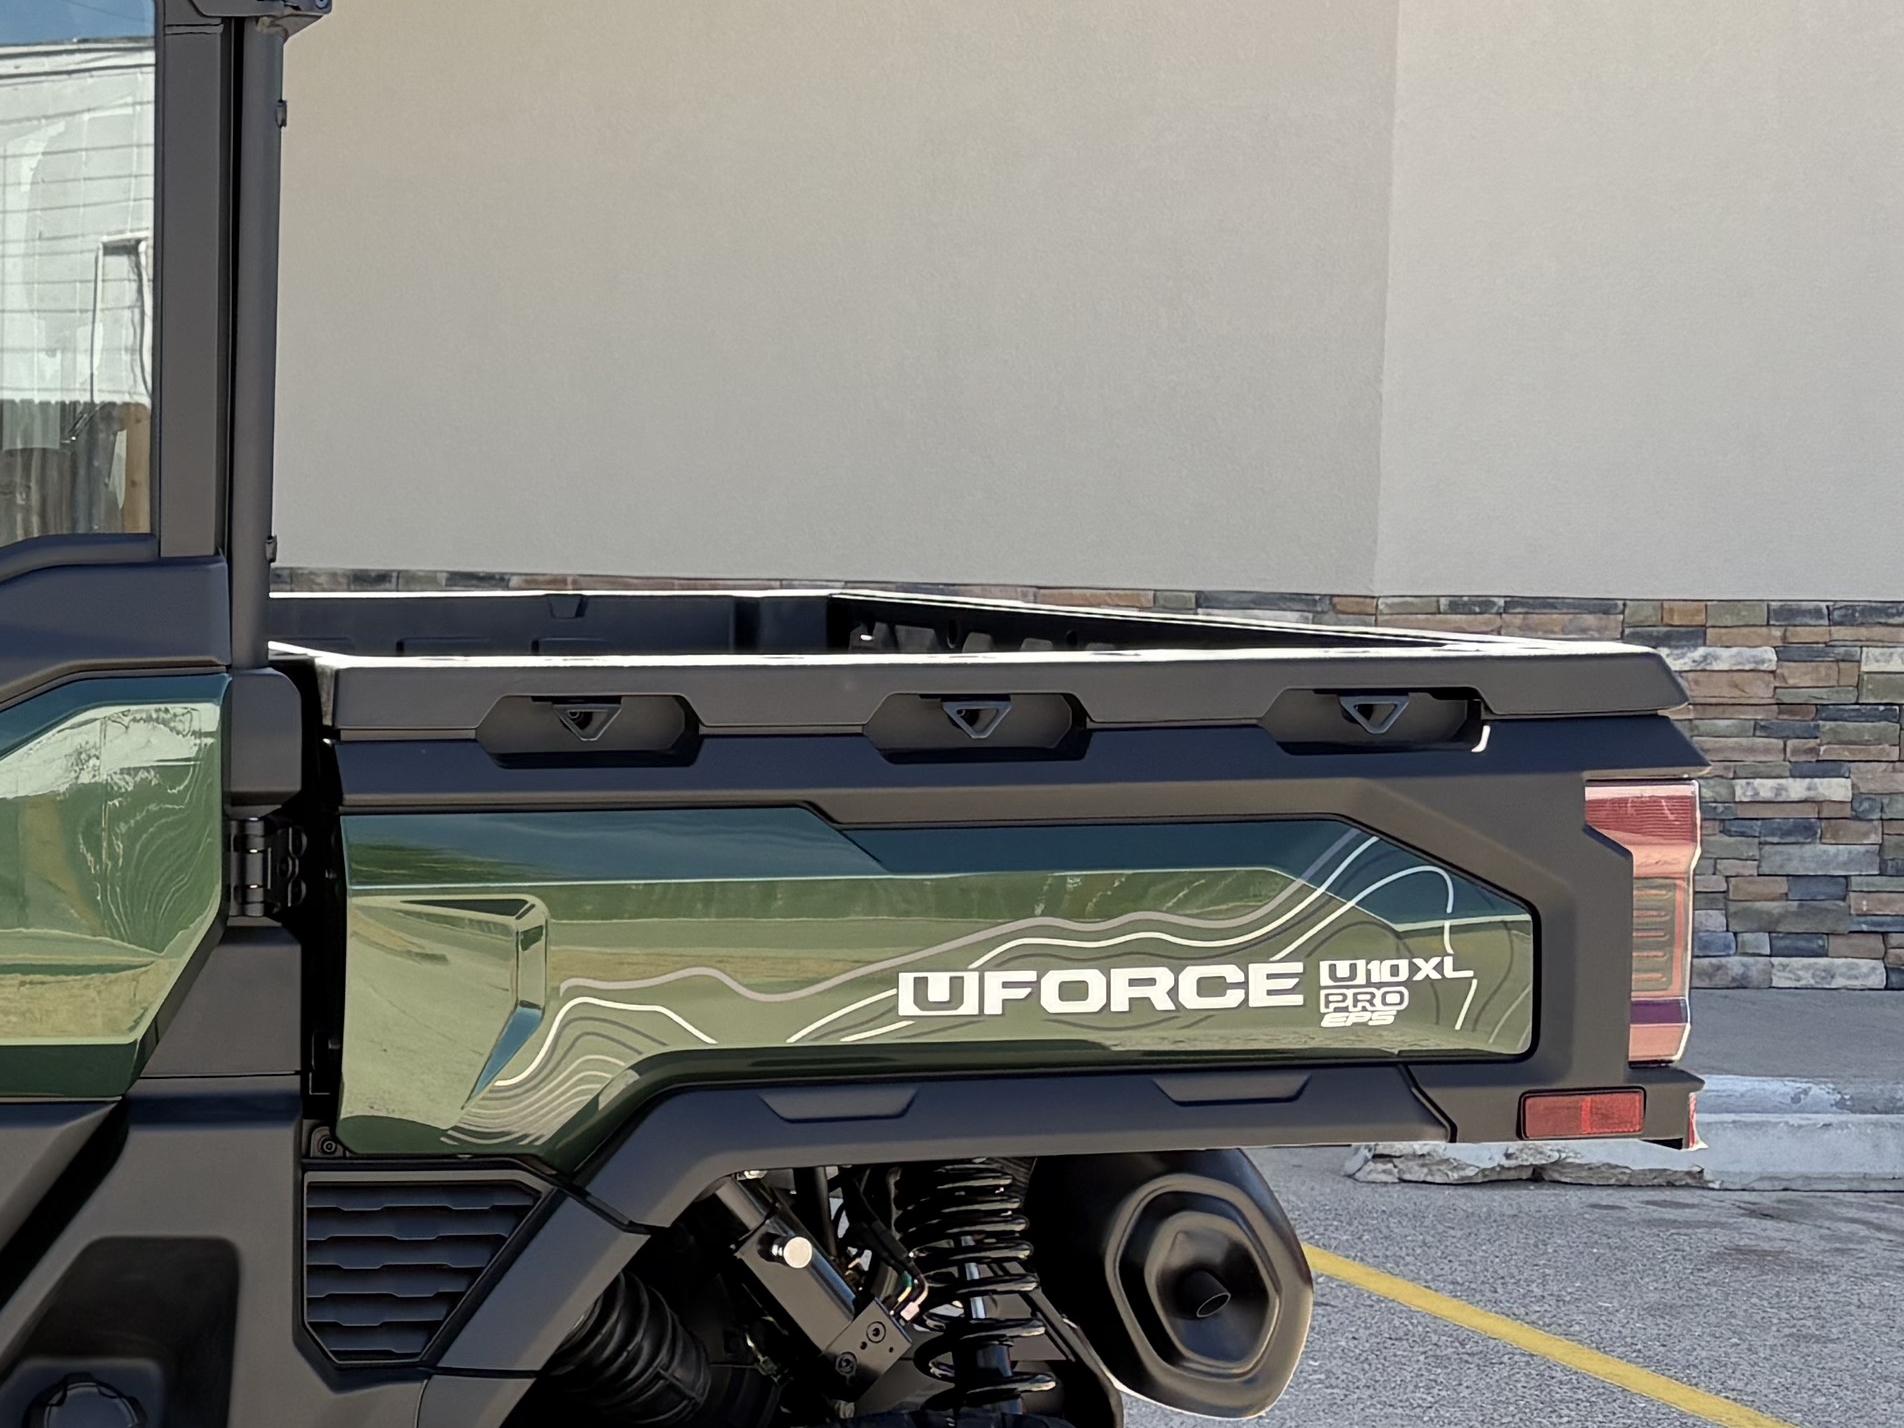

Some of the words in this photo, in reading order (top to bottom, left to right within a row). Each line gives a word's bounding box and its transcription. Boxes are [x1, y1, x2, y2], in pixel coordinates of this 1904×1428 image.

[897, 962, 1305, 1017] UFORCE
[1320, 986, 1410, 1014] PRO
[1320, 1010, 1398, 1028] EPS
